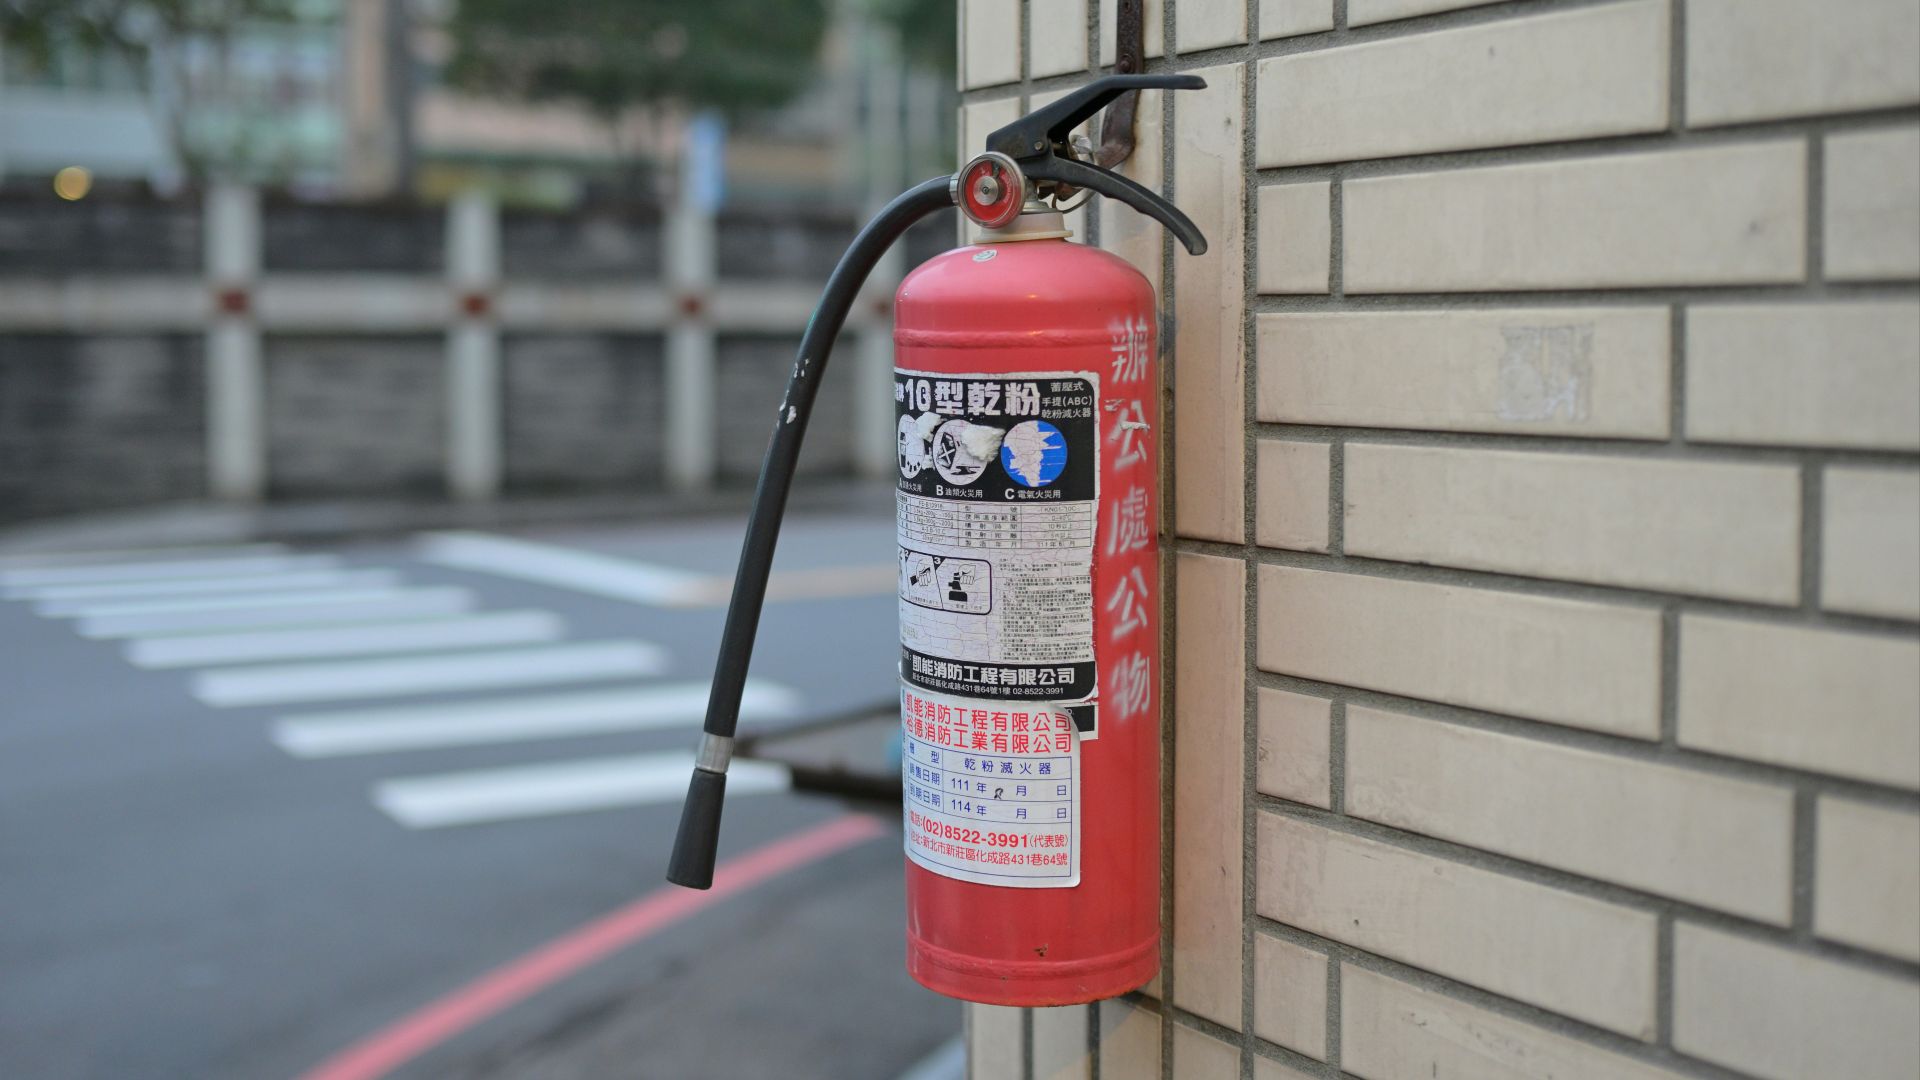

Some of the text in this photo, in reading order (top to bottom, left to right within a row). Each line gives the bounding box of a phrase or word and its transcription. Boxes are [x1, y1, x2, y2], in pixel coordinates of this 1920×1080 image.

[1042, 396, 1093, 407] 手提(ABC)
[936, 485, 944, 496] B
[1005, 488, 1061, 499] C 電氣火災用
[913, 654, 1075, 686] 凱能消防工程有限公司
[1012, 687, 1064, 695] 02-8522-3991
